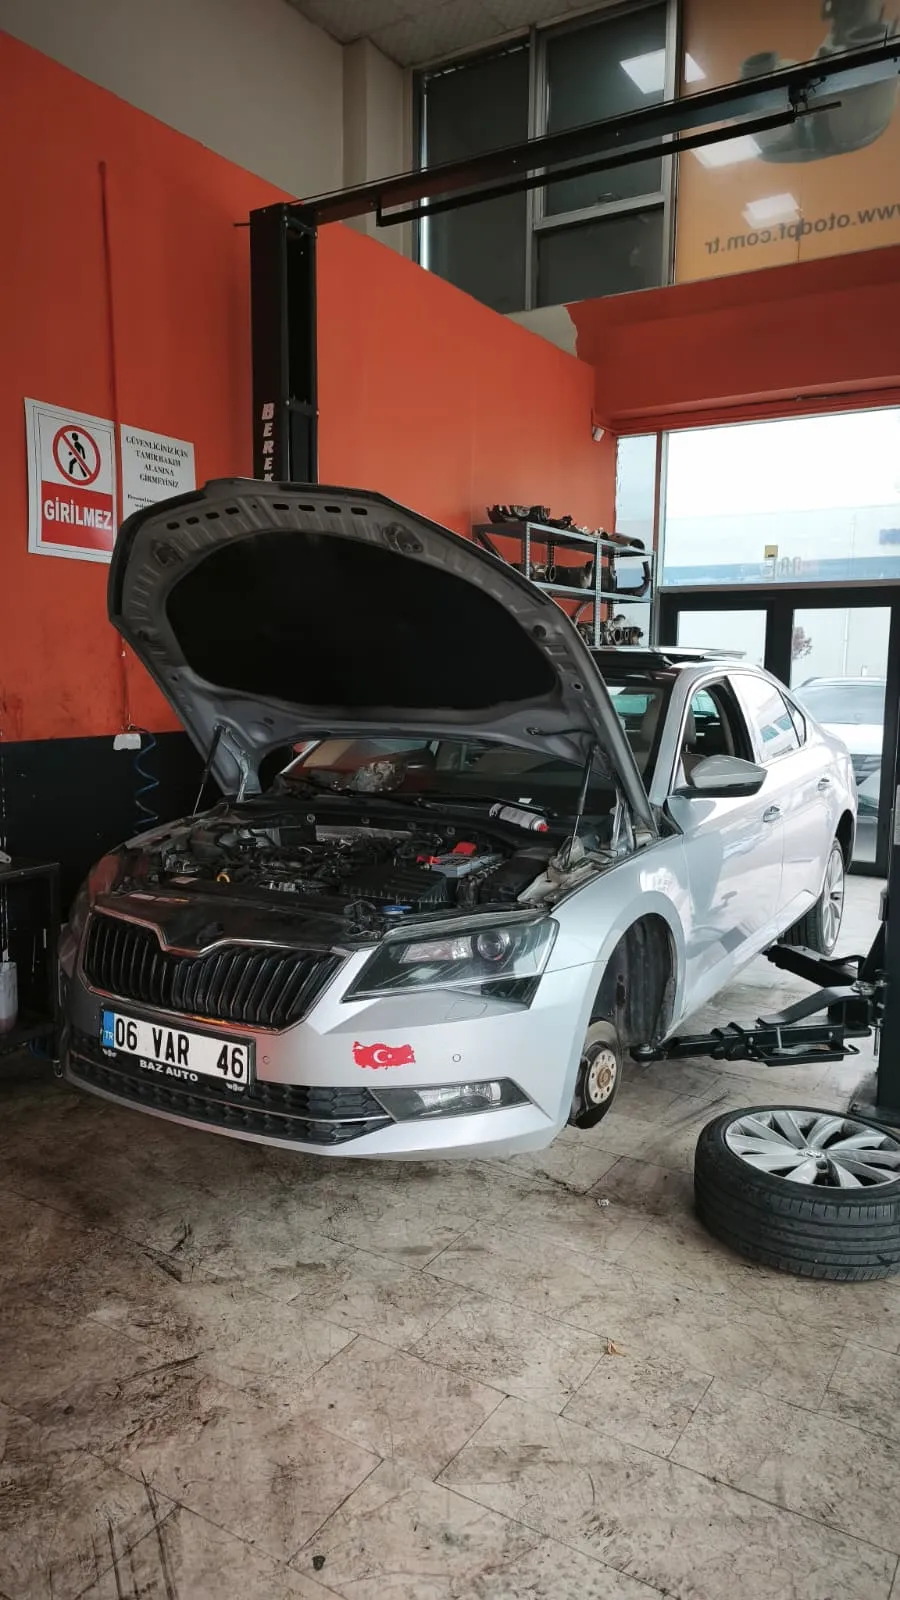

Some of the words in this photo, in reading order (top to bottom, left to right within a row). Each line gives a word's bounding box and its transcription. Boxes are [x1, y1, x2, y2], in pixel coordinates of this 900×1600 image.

[144, 464, 175, 477] ALANINA
[44, 497, 112, 531] GİRİLMEZ
[105, 1031, 114, 1041] TR
[115, 1018, 138, 1051] 06
[152, 1027, 190, 1067] VAR
[217, 1044, 244, 1079] 46
[139, 1059, 164, 1073] BAZ
[165, 1067, 199, 1082] AUTO
